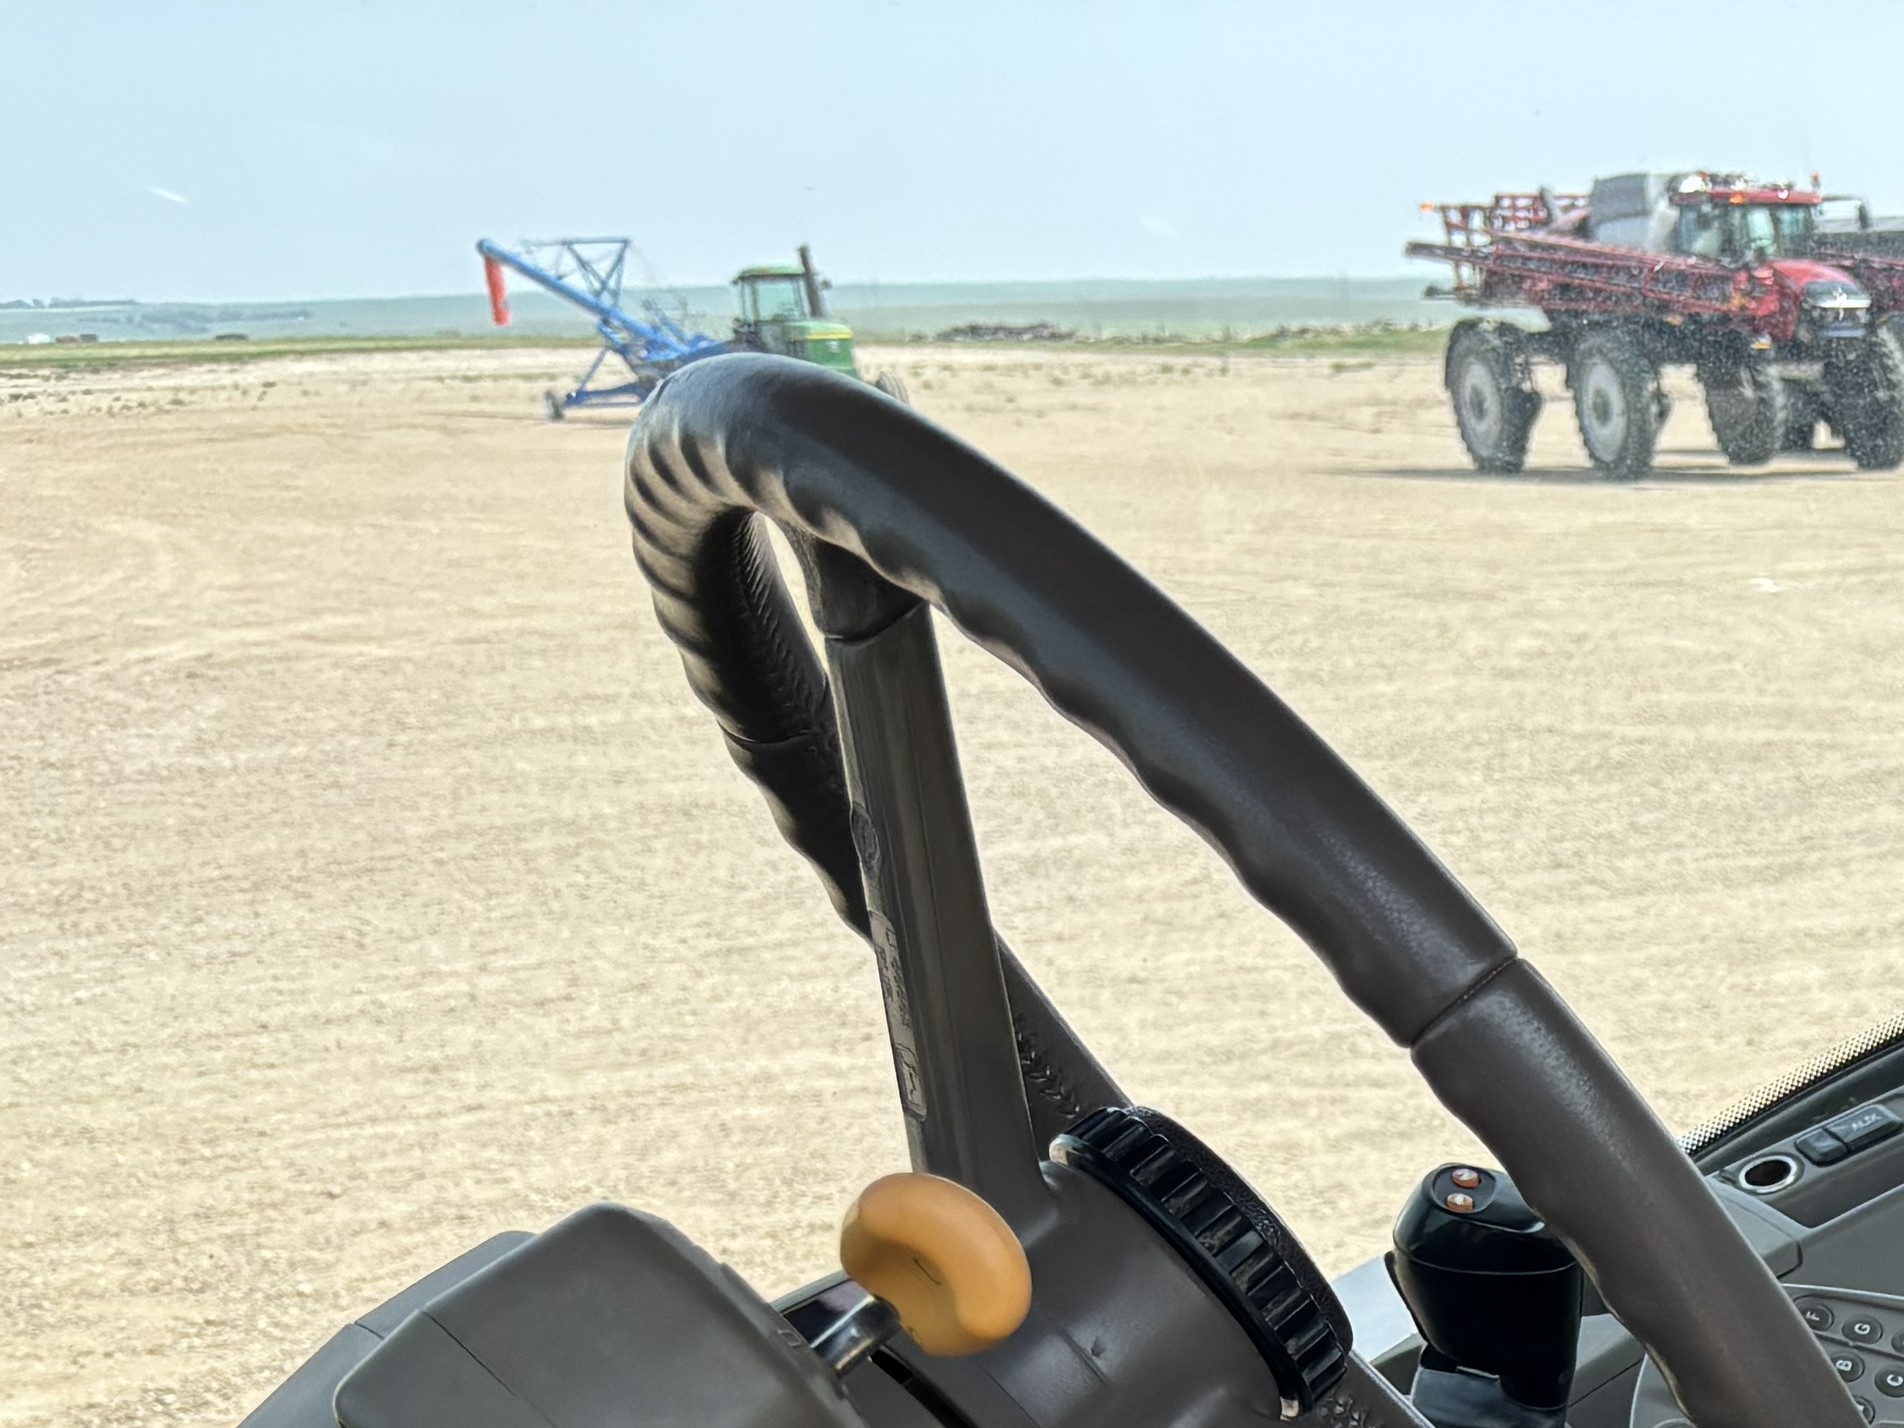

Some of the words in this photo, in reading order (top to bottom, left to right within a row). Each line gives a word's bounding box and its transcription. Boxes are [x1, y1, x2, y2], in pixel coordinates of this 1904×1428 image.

[1805, 1310, 1821, 1322] F
[1854, 1322, 1870, 1335] G
[1835, 1359, 1853, 1371] B
[1887, 1373, 1904, 1386] C
